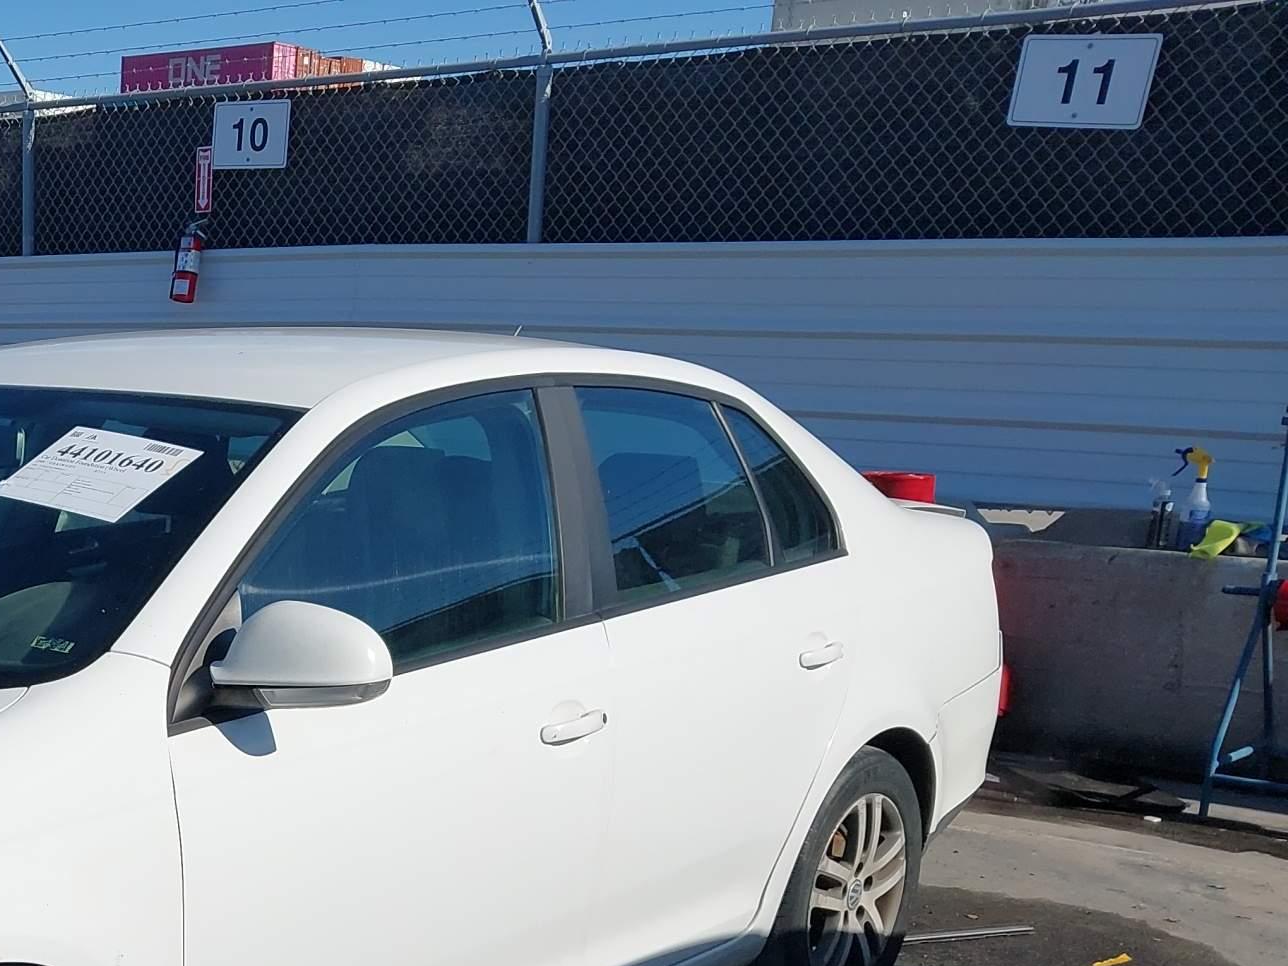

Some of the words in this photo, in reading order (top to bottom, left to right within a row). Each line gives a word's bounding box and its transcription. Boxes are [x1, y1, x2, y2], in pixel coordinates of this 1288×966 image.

[168, 54, 222, 84] ONE
[1056, 58, 1116, 105] 11
[232, 117, 269, 152] 10
[56, 444, 165, 473] 44101640
